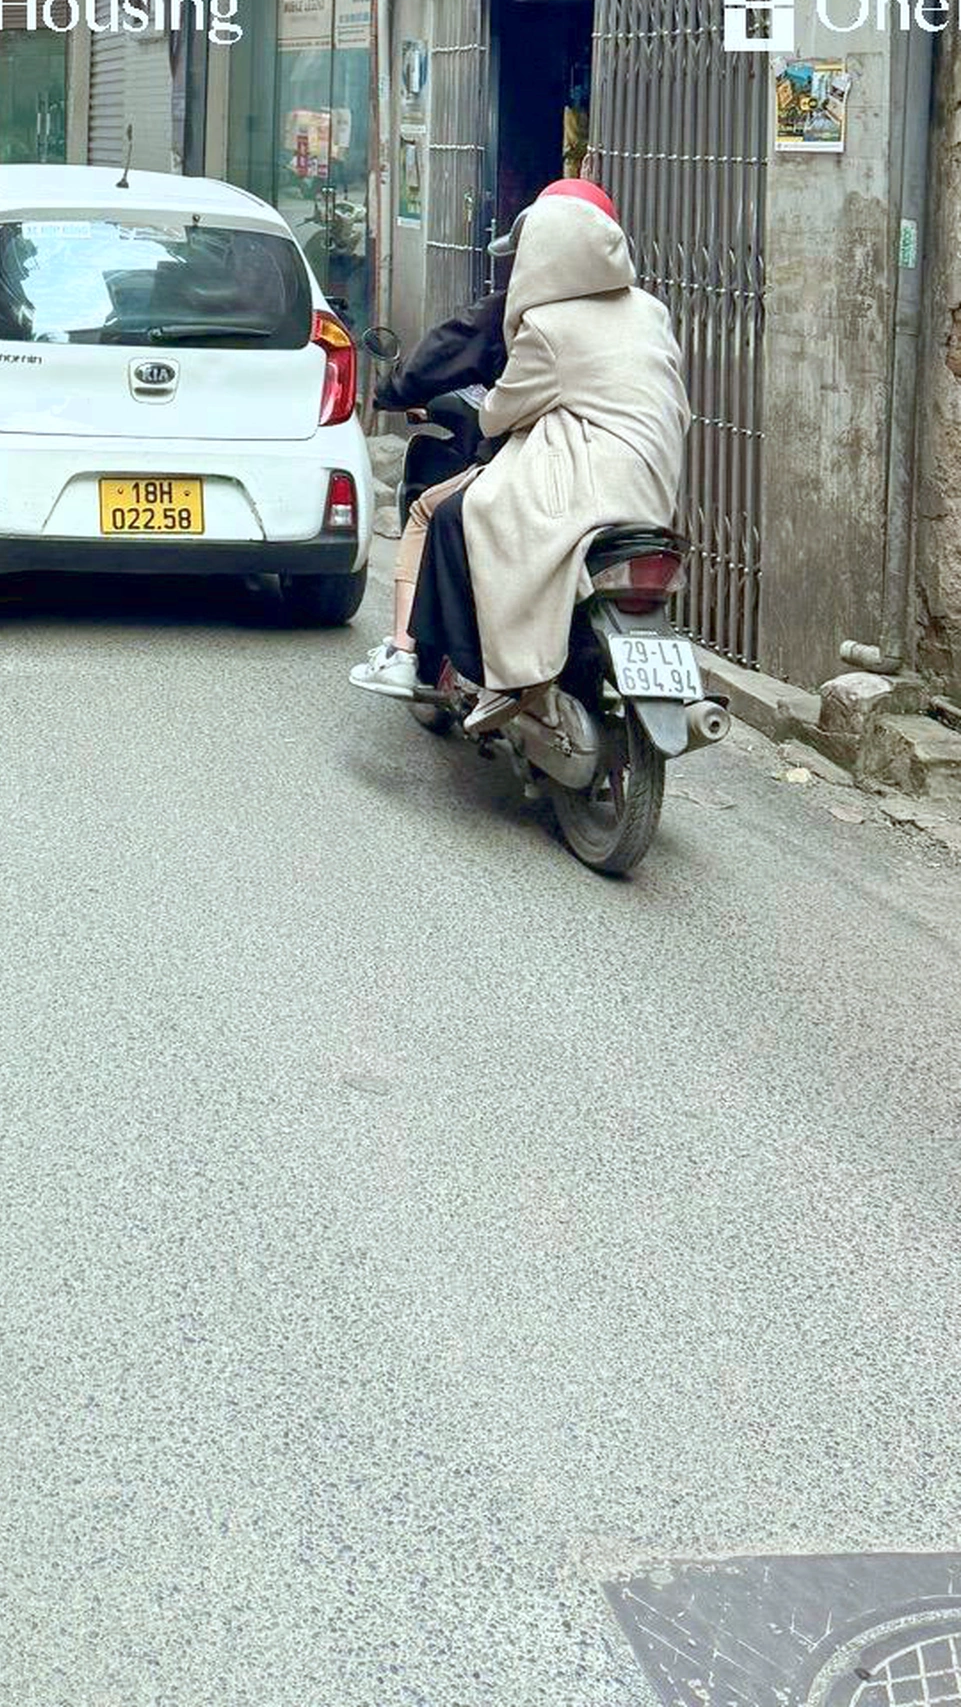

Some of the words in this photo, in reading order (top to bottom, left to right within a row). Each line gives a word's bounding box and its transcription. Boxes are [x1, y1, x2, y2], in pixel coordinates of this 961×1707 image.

[142, 368, 169, 381] KIA
[132, 482, 172, 503] 18H
[112, 508, 191, 530] 022.58
[623, 641, 682, 666] 29-L1
[623, 667, 696, 695] 694.94
